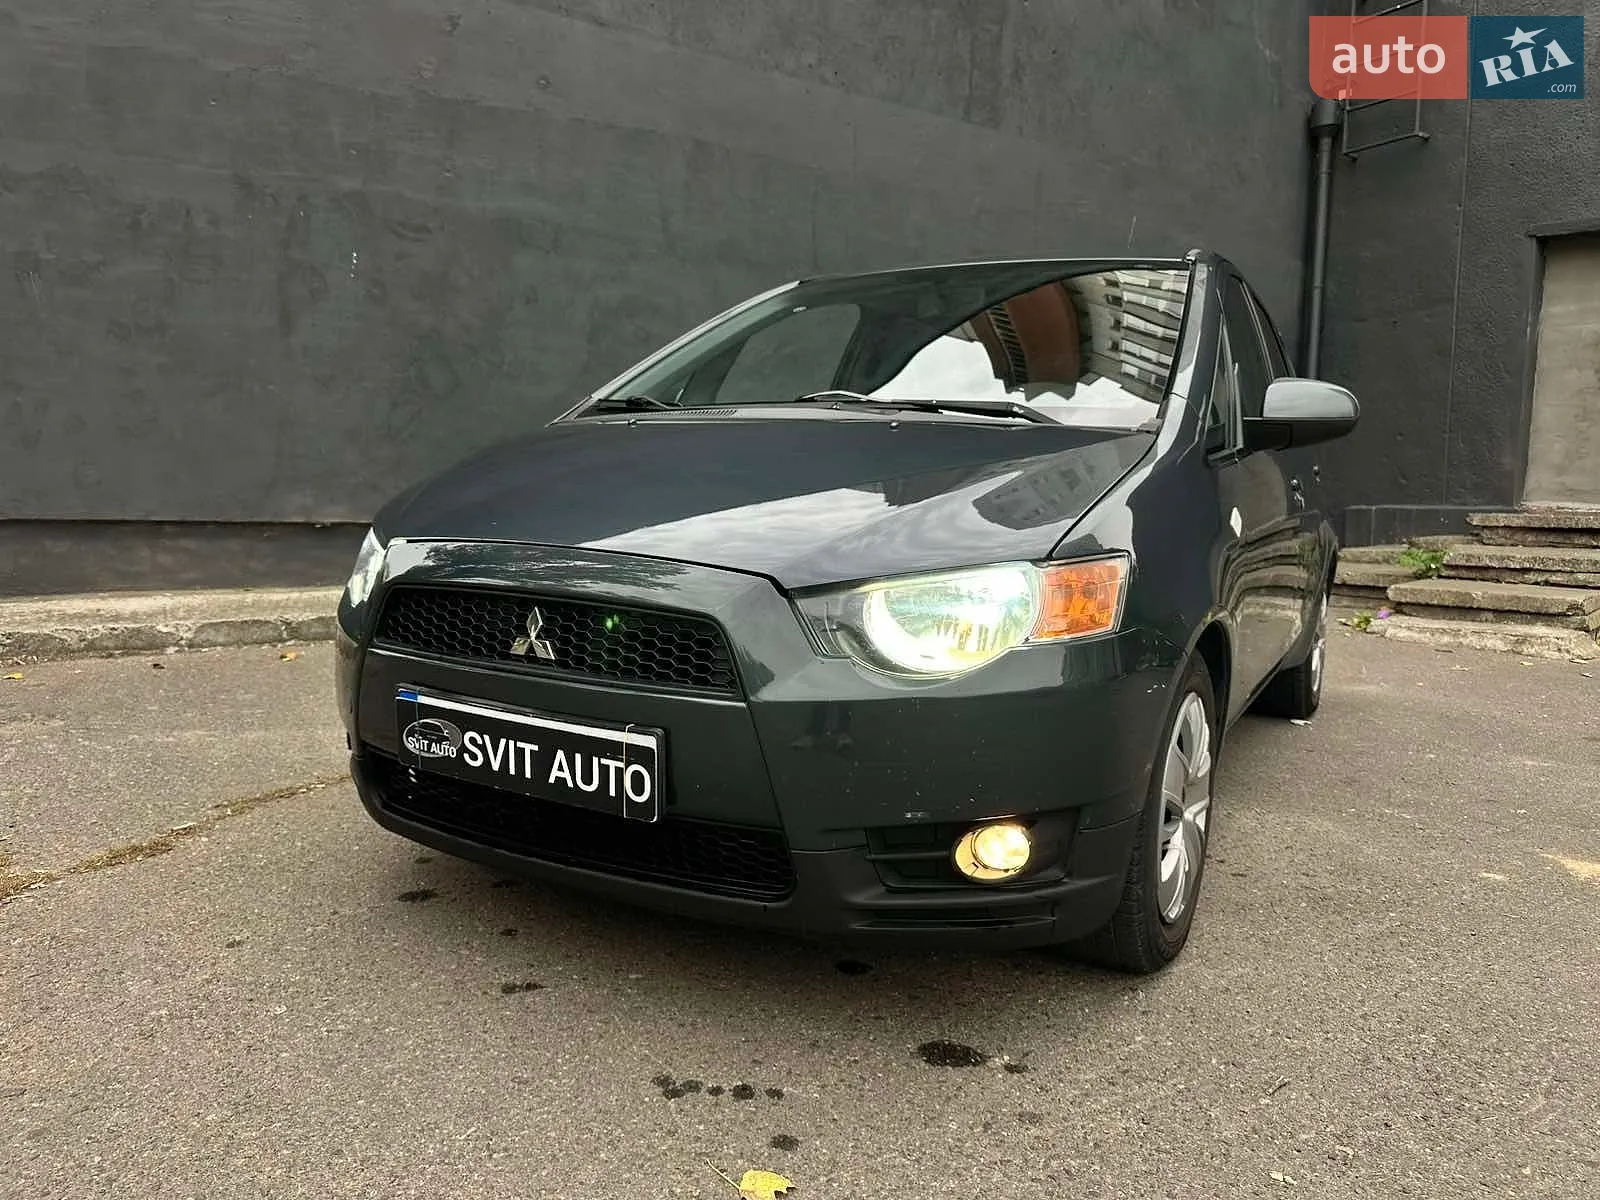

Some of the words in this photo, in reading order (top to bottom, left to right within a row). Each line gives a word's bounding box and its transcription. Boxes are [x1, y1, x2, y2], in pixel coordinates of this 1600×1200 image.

[408, 736, 429, 751] SVIT
[430, 741, 457, 758] AUTO
[463, 731, 538, 779] SVIT
[548, 749, 651, 803] AUTO
